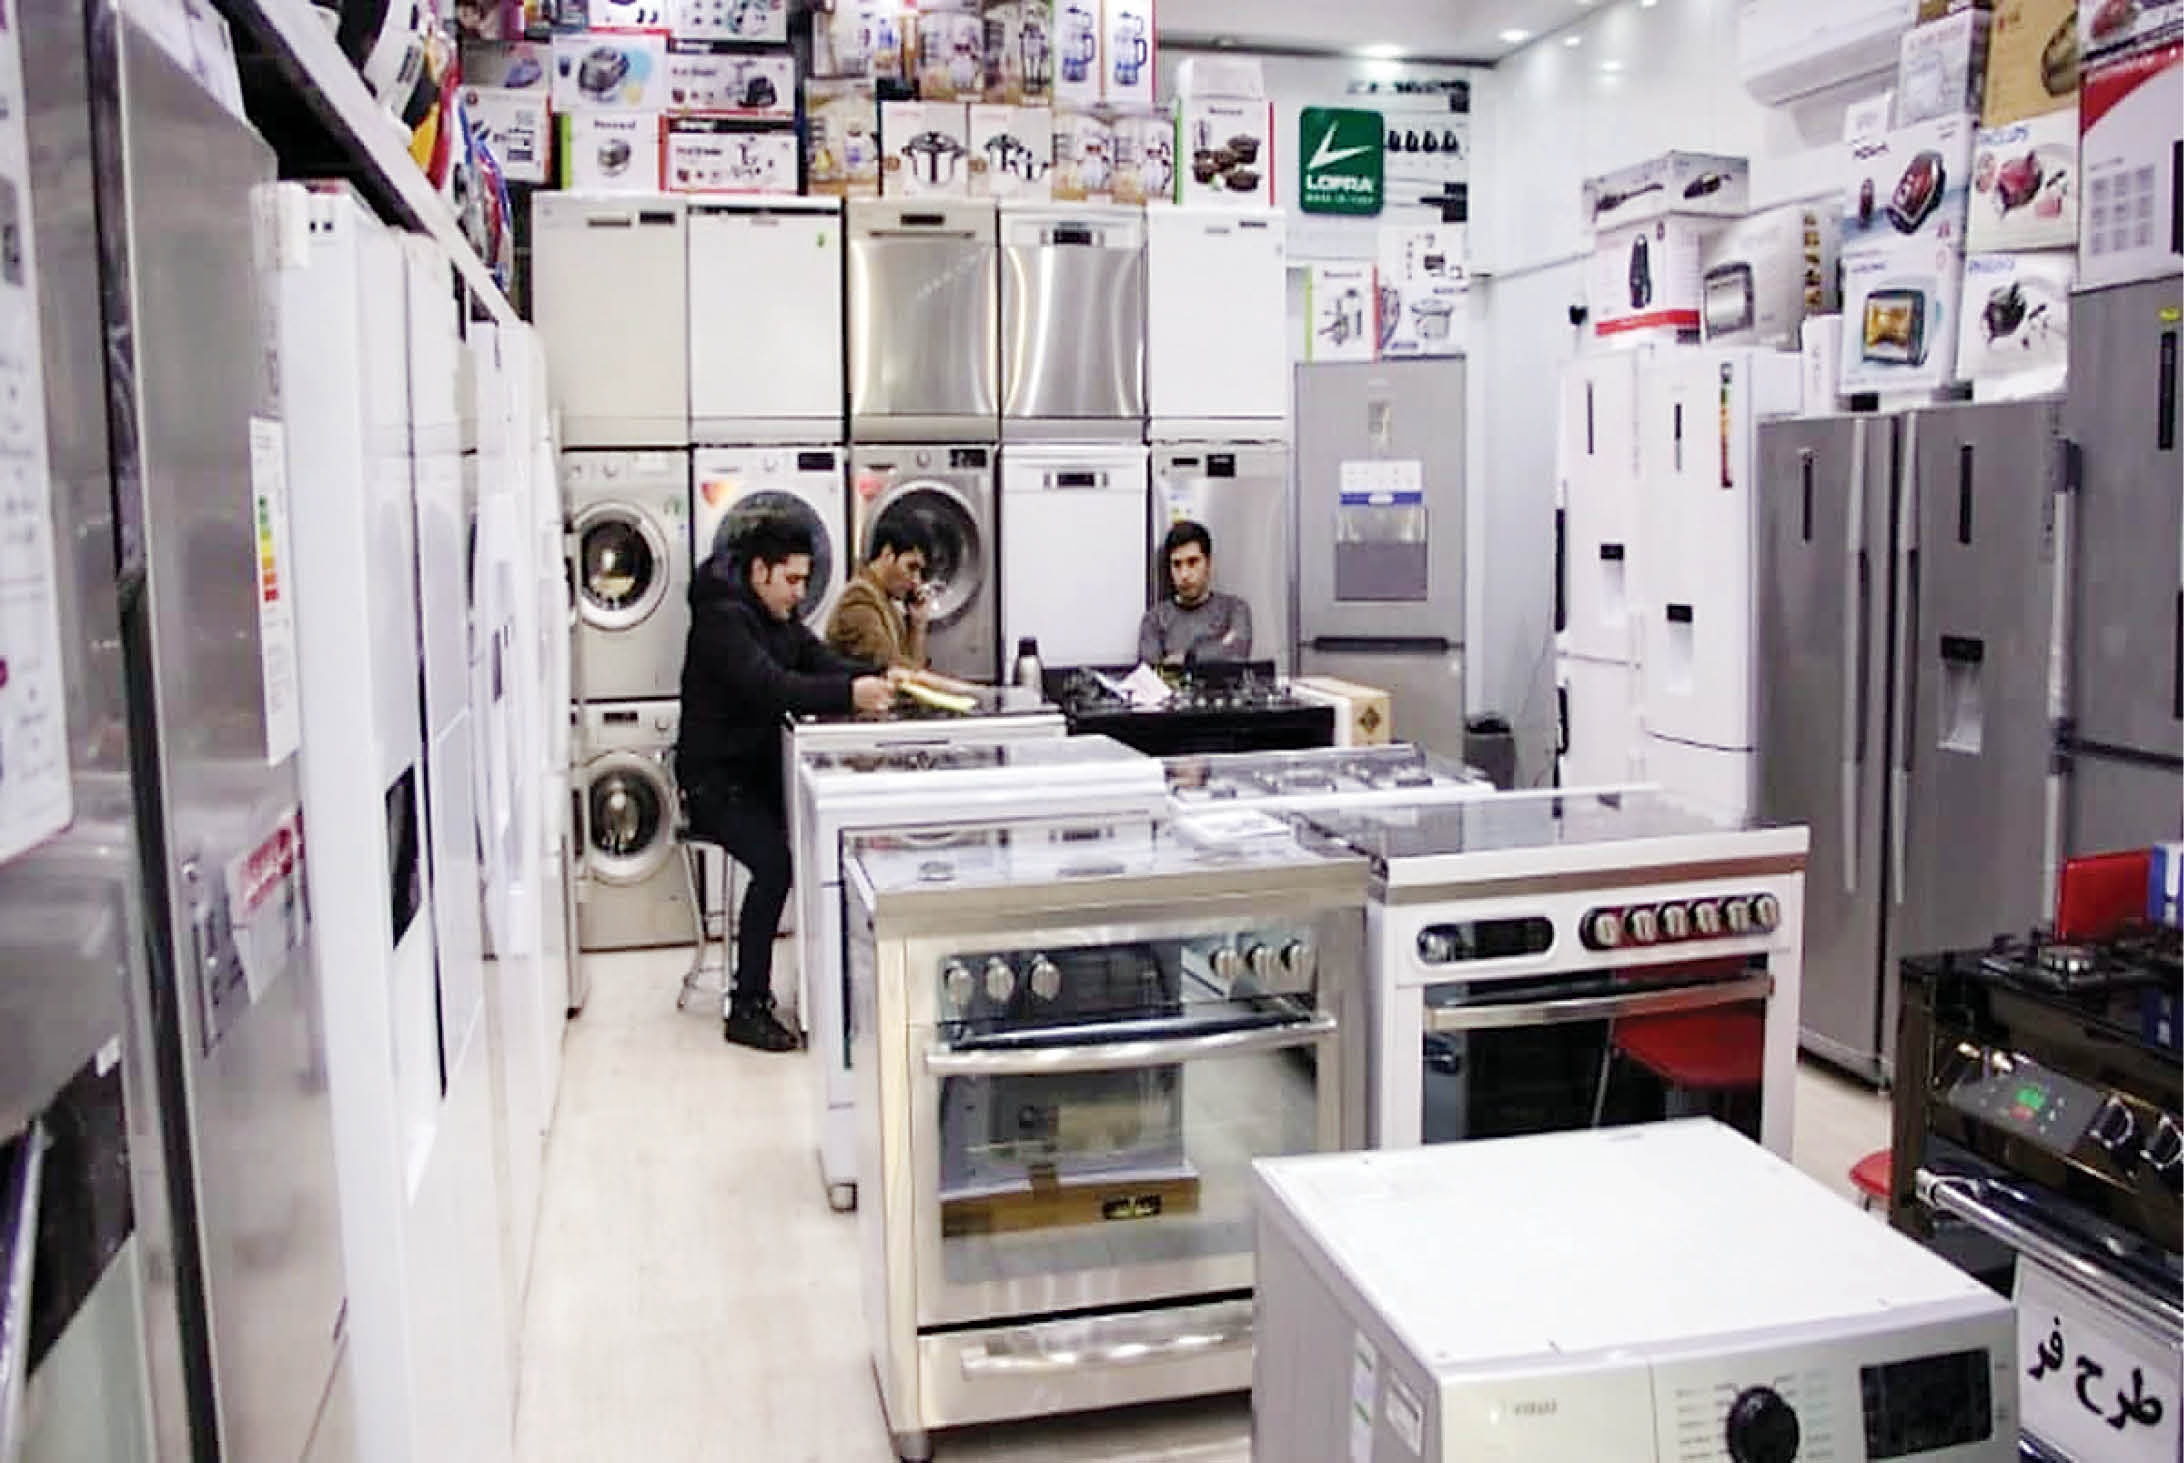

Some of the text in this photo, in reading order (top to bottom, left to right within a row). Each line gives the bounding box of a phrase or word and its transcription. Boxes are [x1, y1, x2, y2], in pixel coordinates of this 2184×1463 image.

[1306, 174, 1373, 192] LOFRA
[2027, 1316, 2163, 1429] طرح فر
